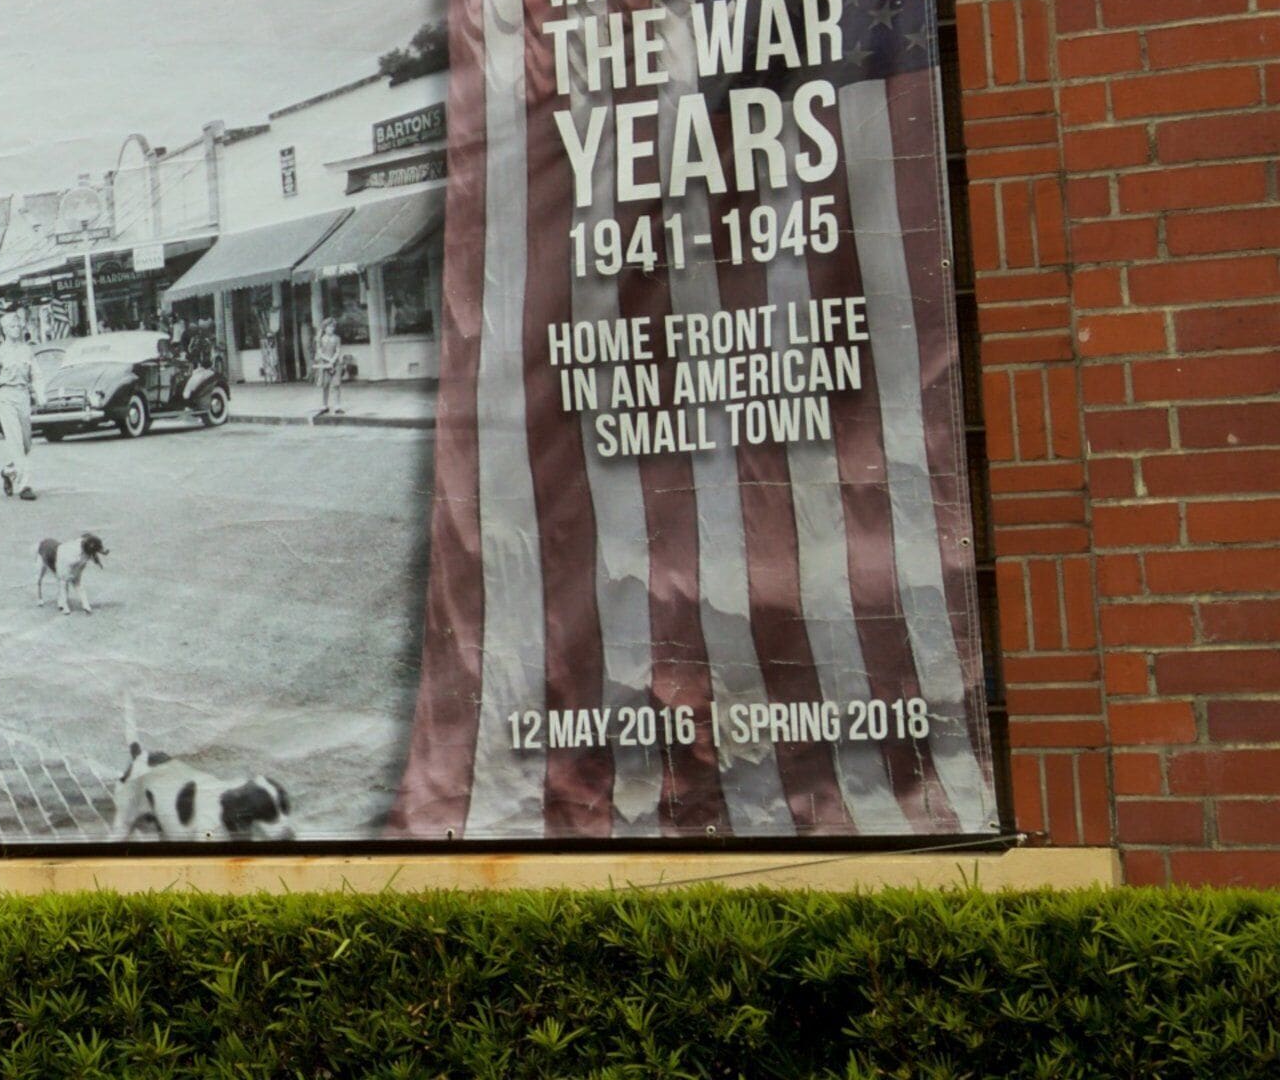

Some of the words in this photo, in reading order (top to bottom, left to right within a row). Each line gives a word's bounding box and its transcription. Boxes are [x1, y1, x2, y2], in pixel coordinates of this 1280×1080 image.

[542, 7, 669, 95] THE
[553, 79, 839, 208] YEARS
[547, 316, 653, 366] HOME
[665, 304, 778, 357] FRONT
[787, 296, 870, 344] LIFE
[560, 367, 598, 412] IN
[611, 364, 660, 409] AN
[673, 345, 862, 405] AMERICAN
[595, 407, 716, 458] SMALL
[725, 396, 831, 447] TOWN
[508, 710, 542, 749] 12
[549, 708, 611, 748] MAY
[618, 705, 696, 747] 2016
[731, 700, 841, 744] SPRING
[848, 697, 930, 740] 2018
